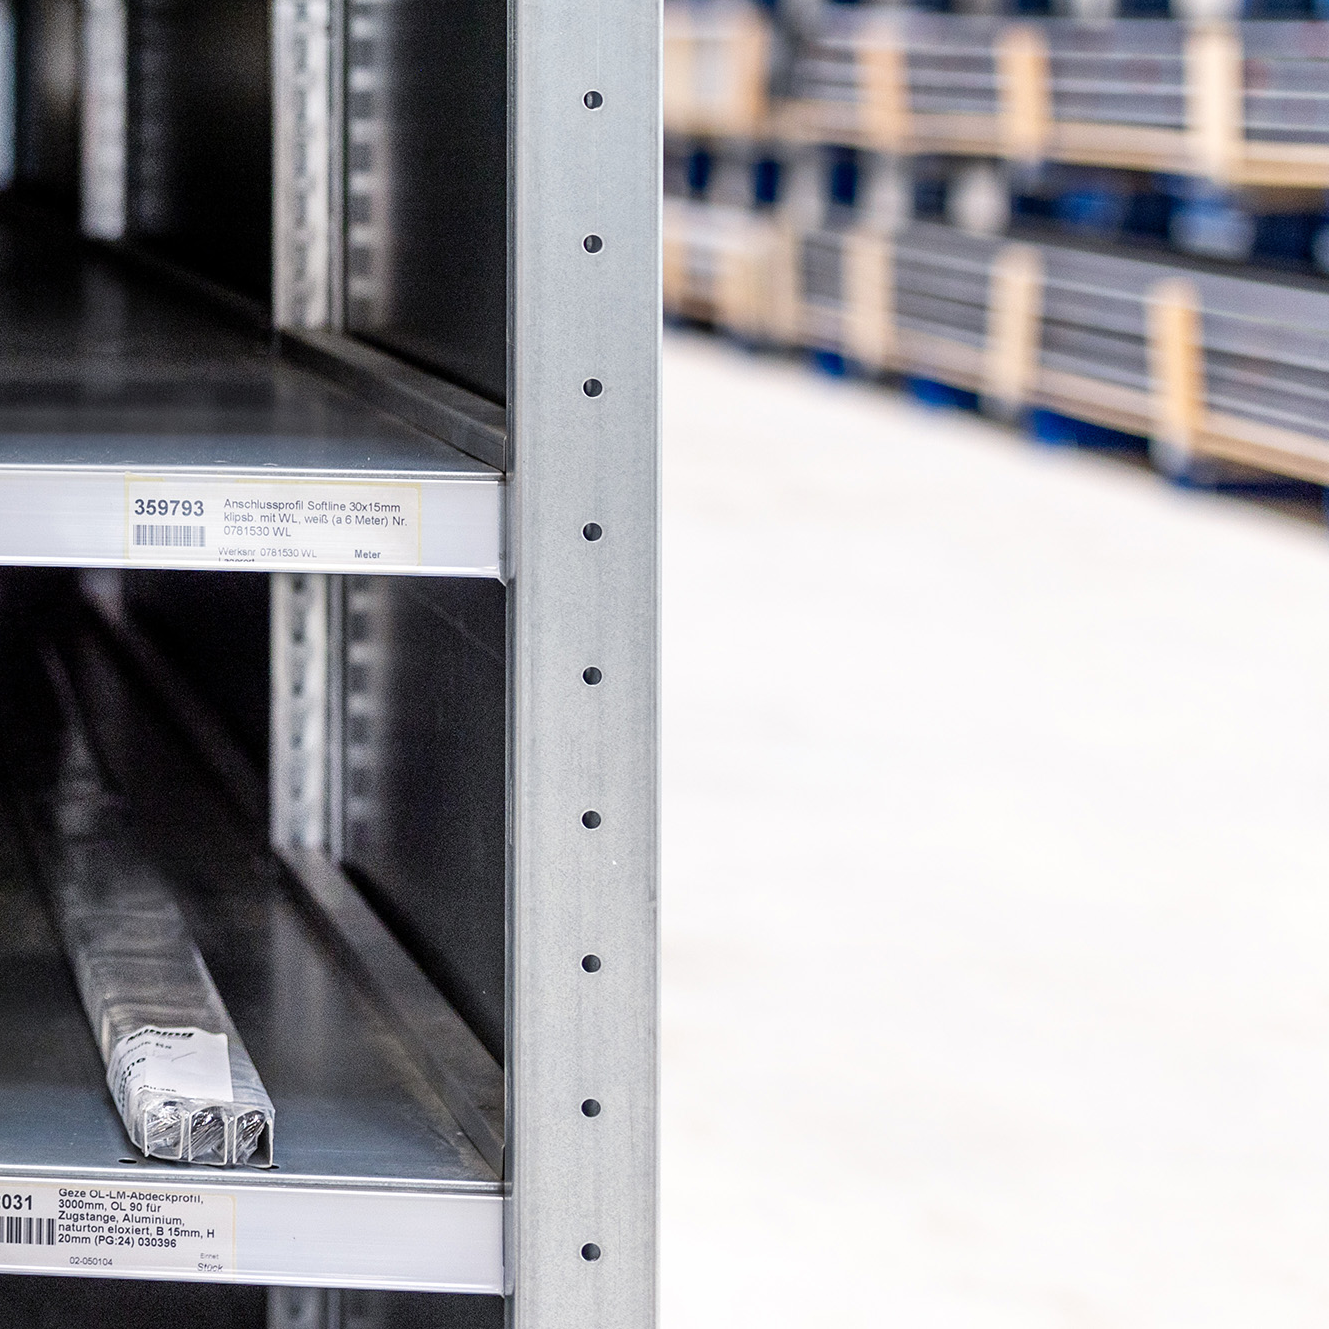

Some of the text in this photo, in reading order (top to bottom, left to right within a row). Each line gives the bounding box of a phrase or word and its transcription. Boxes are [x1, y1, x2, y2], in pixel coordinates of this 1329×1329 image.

[135, 499, 204, 516] 359793
[224, 499, 400, 512] Anschlussprofil Softline 30x15mm
[224, 513, 407, 527] klipsb. mit WL, weiß (a 6 Meter) Nr.
[224, 525, 291, 536] 0781530 WL
[219, 547, 381, 558] Werksnr 0781530 WL Meter
[59, 1188, 204, 1204] Geze OL-LM-Abdeckprofil,
[59, 1200, 161, 1212] 3000mm, OL 90 für
[59, 1211, 185, 1226] Zugstange, Aluminium,
[59, 1223, 215, 1239] naturton eloxiert, B 15mm, H
[58, 1234, 177, 1248] 20mm (PG:24) 030396
[69, 1256, 113, 1266] 02-050104
